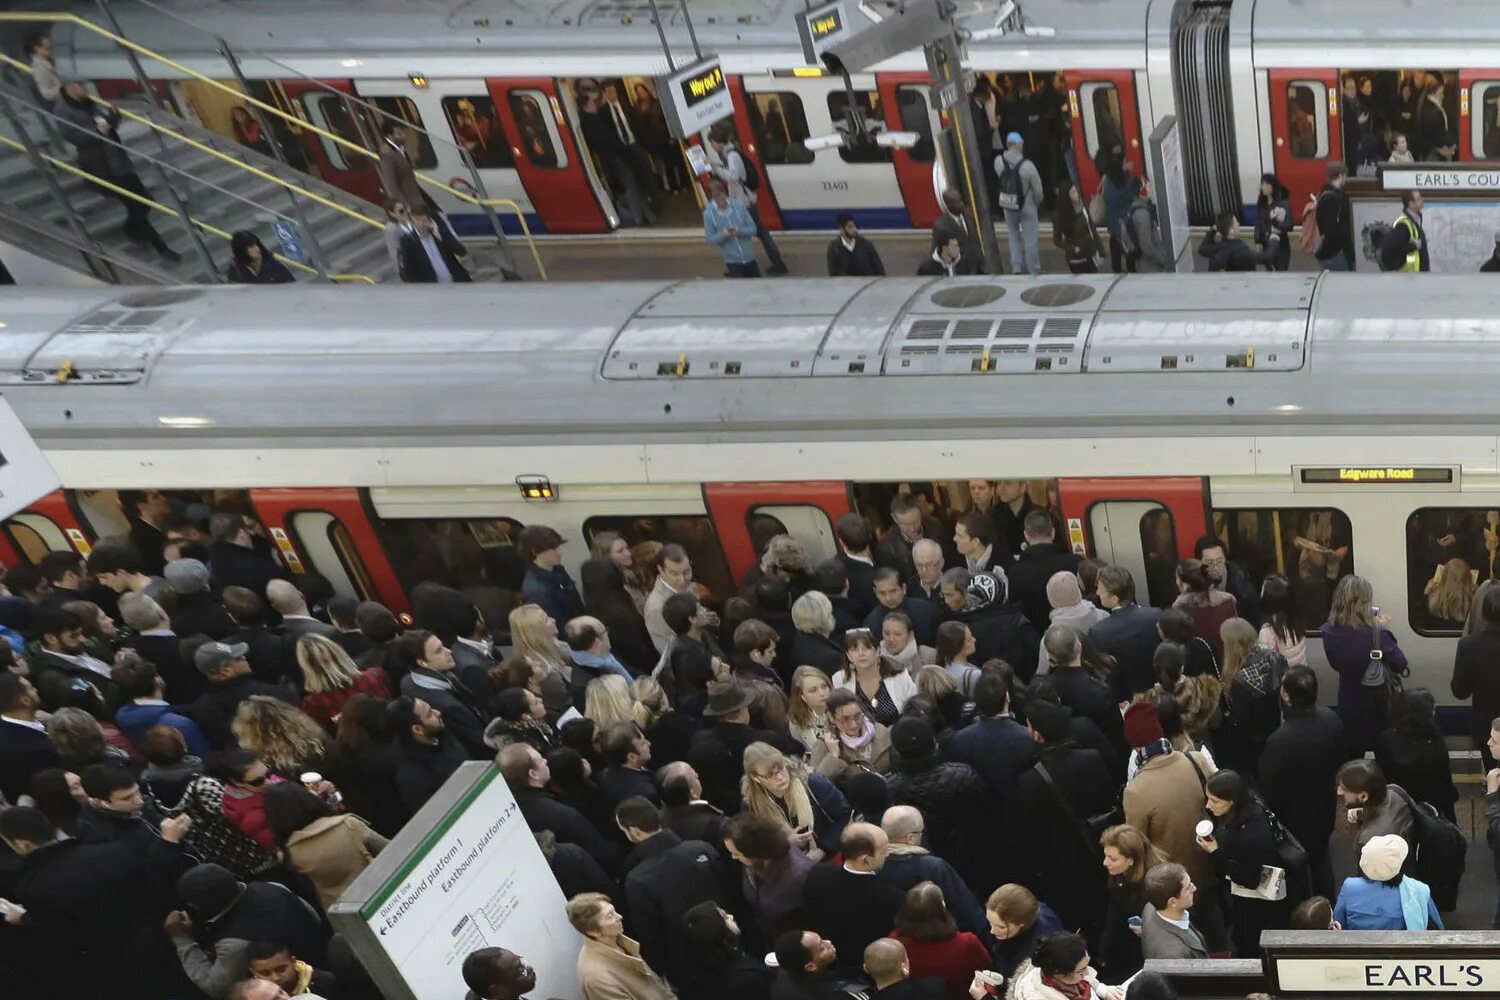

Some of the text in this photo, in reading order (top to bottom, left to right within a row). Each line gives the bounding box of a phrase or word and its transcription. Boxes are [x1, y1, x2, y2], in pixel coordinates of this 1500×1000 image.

[1415, 173, 1460, 186] EARL'S
[1340, 468, 1414, 481] Edgware Road
[440, 846, 479, 893] Eastbound
[476, 815, 507, 854] platform
[385, 879, 428, 929] Eastbound
[426, 845, 460, 886] platform
[380, 893, 402, 917] District
[1364, 965, 1483, 987] EARL'S
